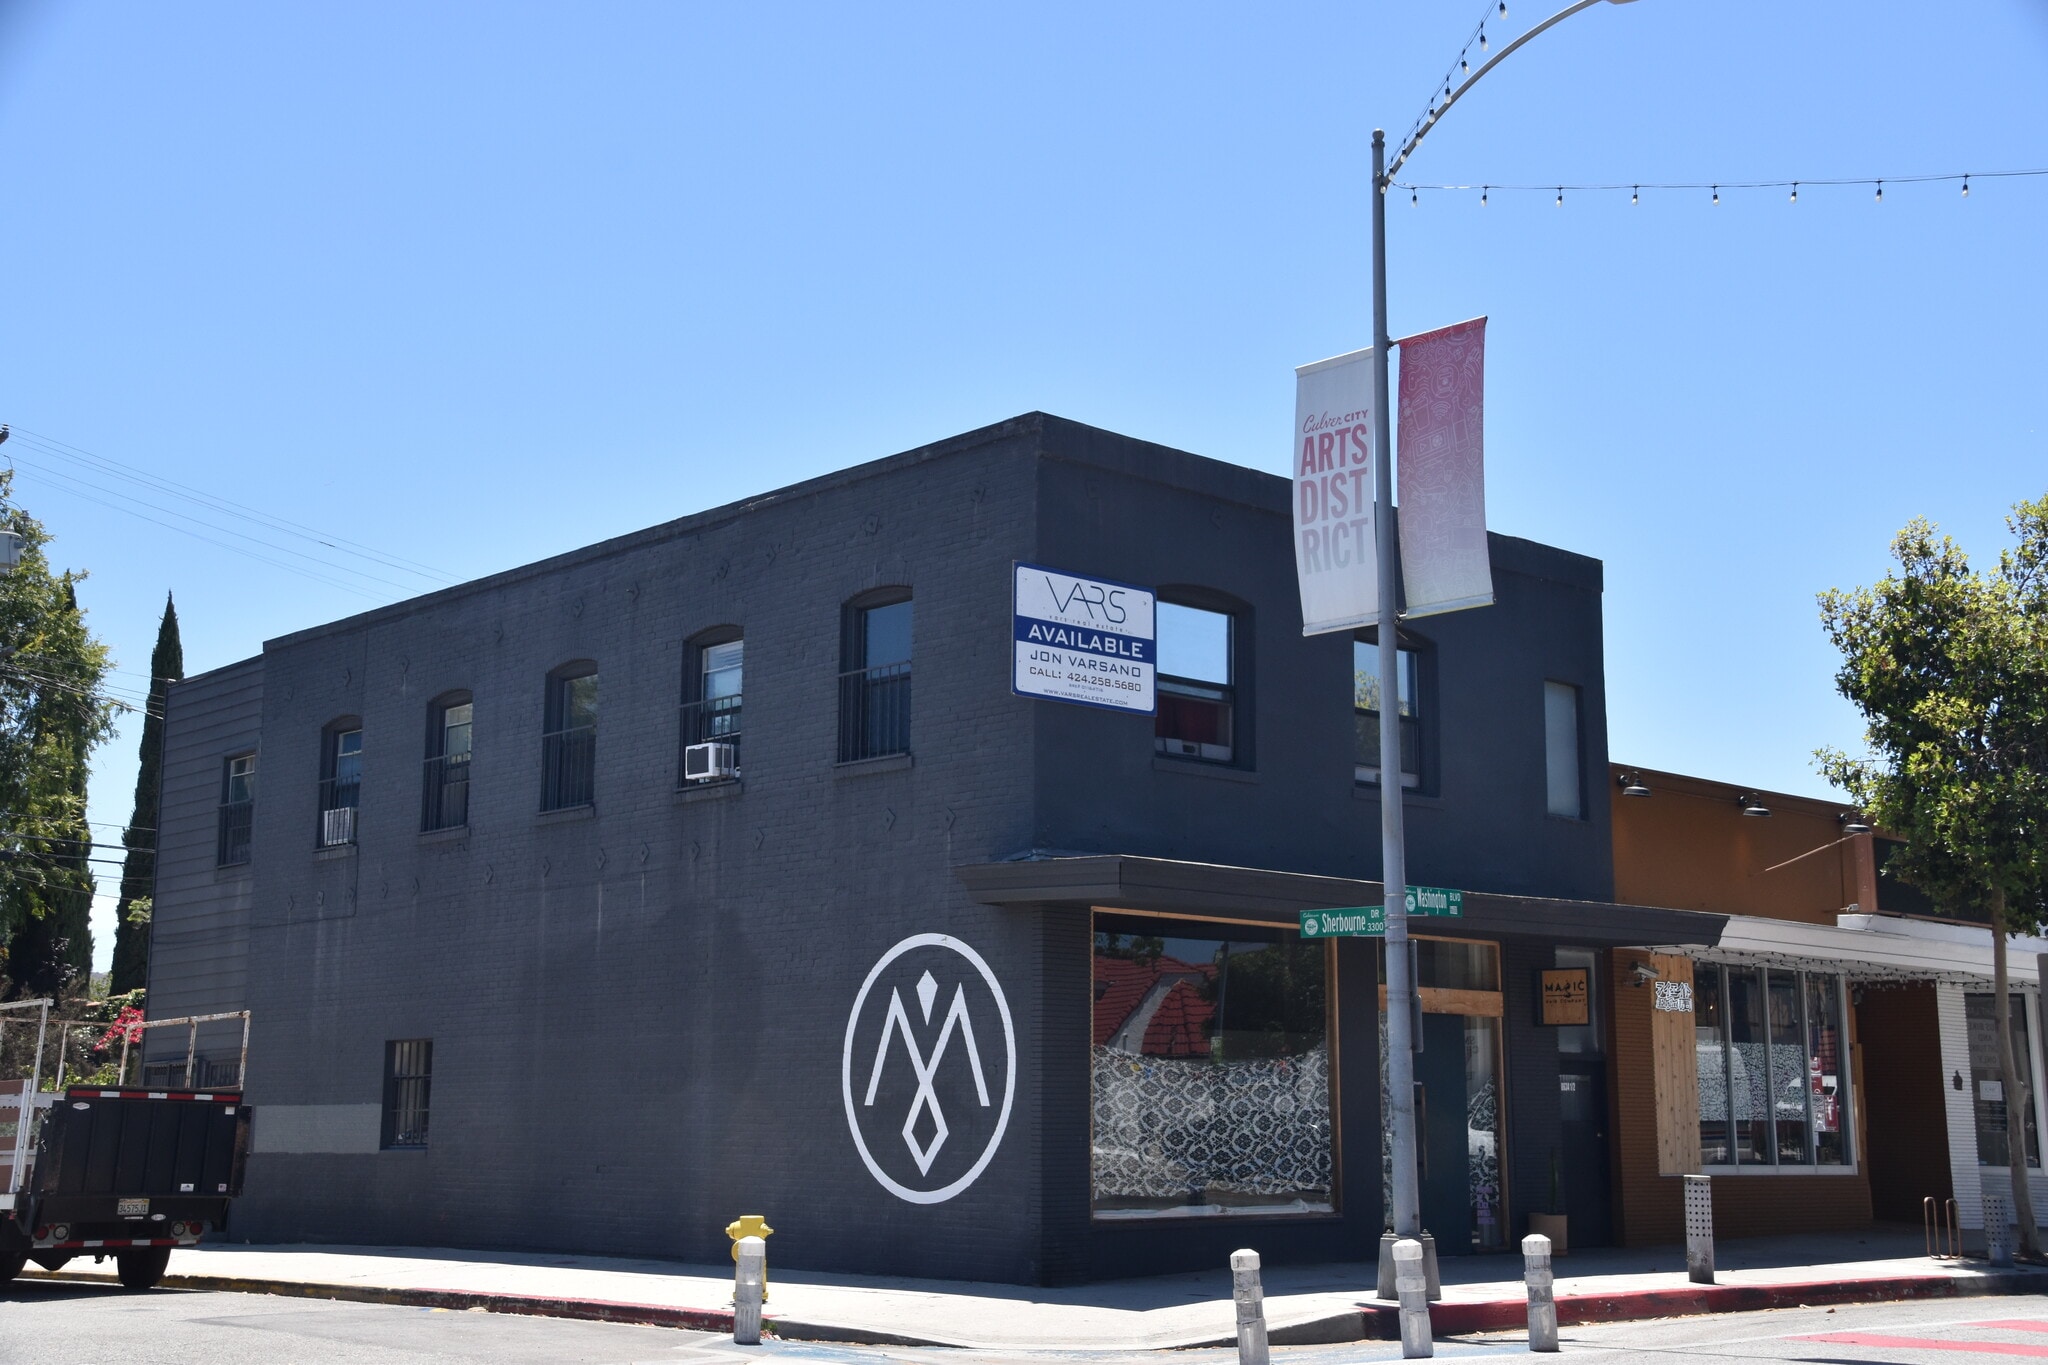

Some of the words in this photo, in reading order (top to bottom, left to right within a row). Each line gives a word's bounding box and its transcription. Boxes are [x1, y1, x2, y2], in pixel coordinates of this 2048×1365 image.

[1303, 410, 1343, 433] Culver
[1344, 409, 1369, 424] CITY
[1300, 424, 1368, 477] ARTS
[1300, 467, 1367, 525] DIST
[1302, 517, 1368, 576] RICT
[1045, 576, 1126, 624] VARS
[1028, 624, 1143, 658] AVAILABLE
[1030, 650, 1062, 665] JON
[1068, 655, 1141, 678] VARSANO
[1029, 667, 1062, 679] CALL:
[1067, 672, 1141, 692] 424.258.5680
[1417, 888, 1448, 915] Washington
[1449, 892, 1461, 902] BLVD
[1321, 913, 1366, 933] Sherbourne
[1371, 909, 1380, 919] DR
[1367, 922, 1384, 932] 3300
